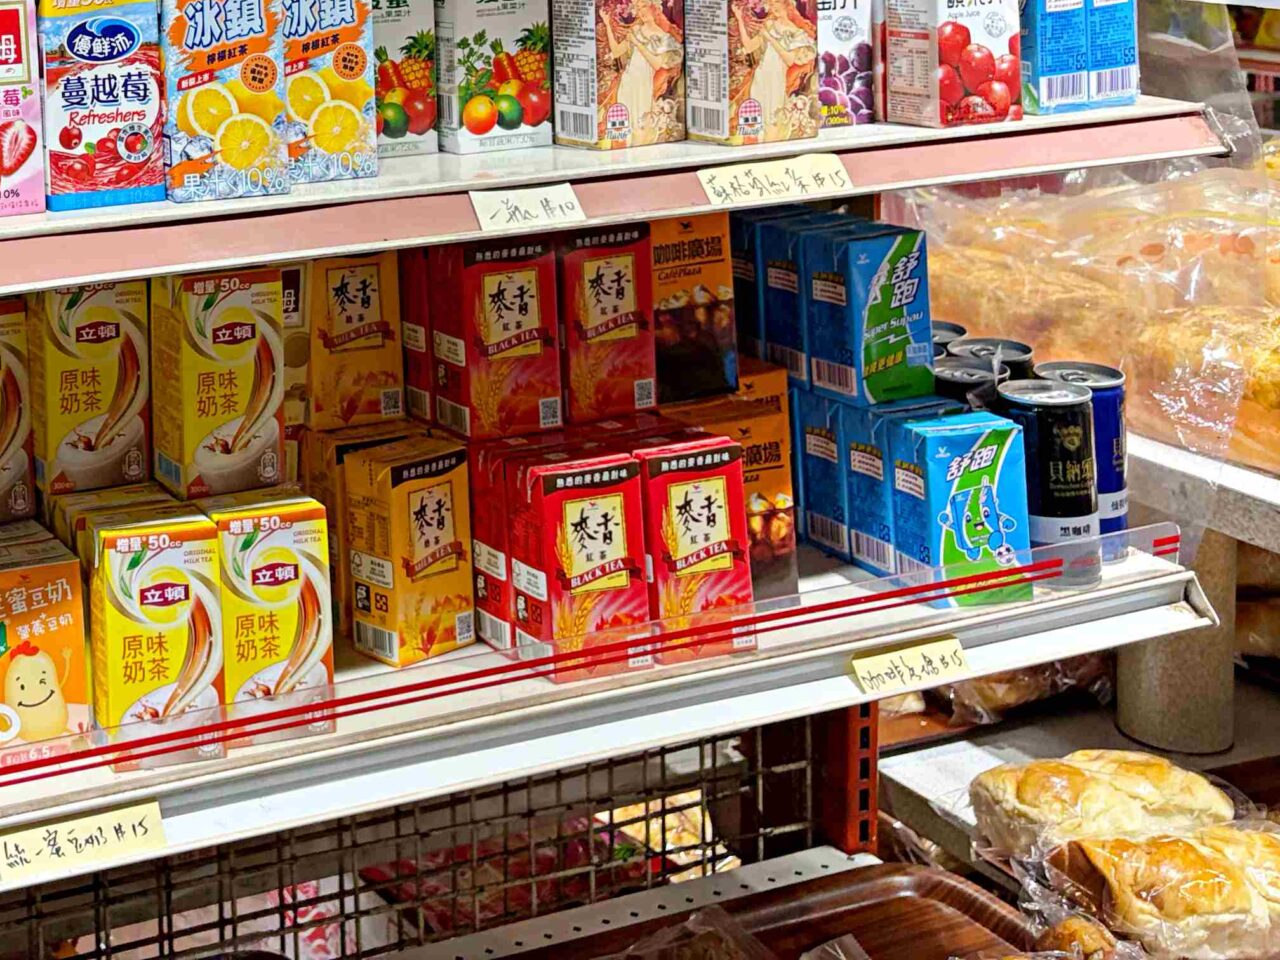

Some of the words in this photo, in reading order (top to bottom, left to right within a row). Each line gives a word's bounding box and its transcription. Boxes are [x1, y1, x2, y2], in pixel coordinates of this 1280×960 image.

[72, 32, 131, 57] 優鮮沛
[61, 72, 150, 108] 蔓越莓
[69, 109, 147, 127] Refreshers
[653, 236, 722, 264] 咖啡廣場
[890, 251, 920, 309] 舒跑
[947, 443, 998, 482] 舒跑
[676, 491, 723, 536] 麥香
[570, 506, 620, 554] 麥香
[1060, 524, 1090, 536] 黑咖啡
[676, 552, 708, 570] BLACK
[709, 544, 728, 556] TEA
[255, 564, 296, 584] 立頓
[570, 567, 603, 588] BLACK
[604, 560, 624, 573] TEA
[143, 583, 186, 604] 立頓
[235, 611, 279, 638] 原味
[122, 632, 168, 659] 原味
